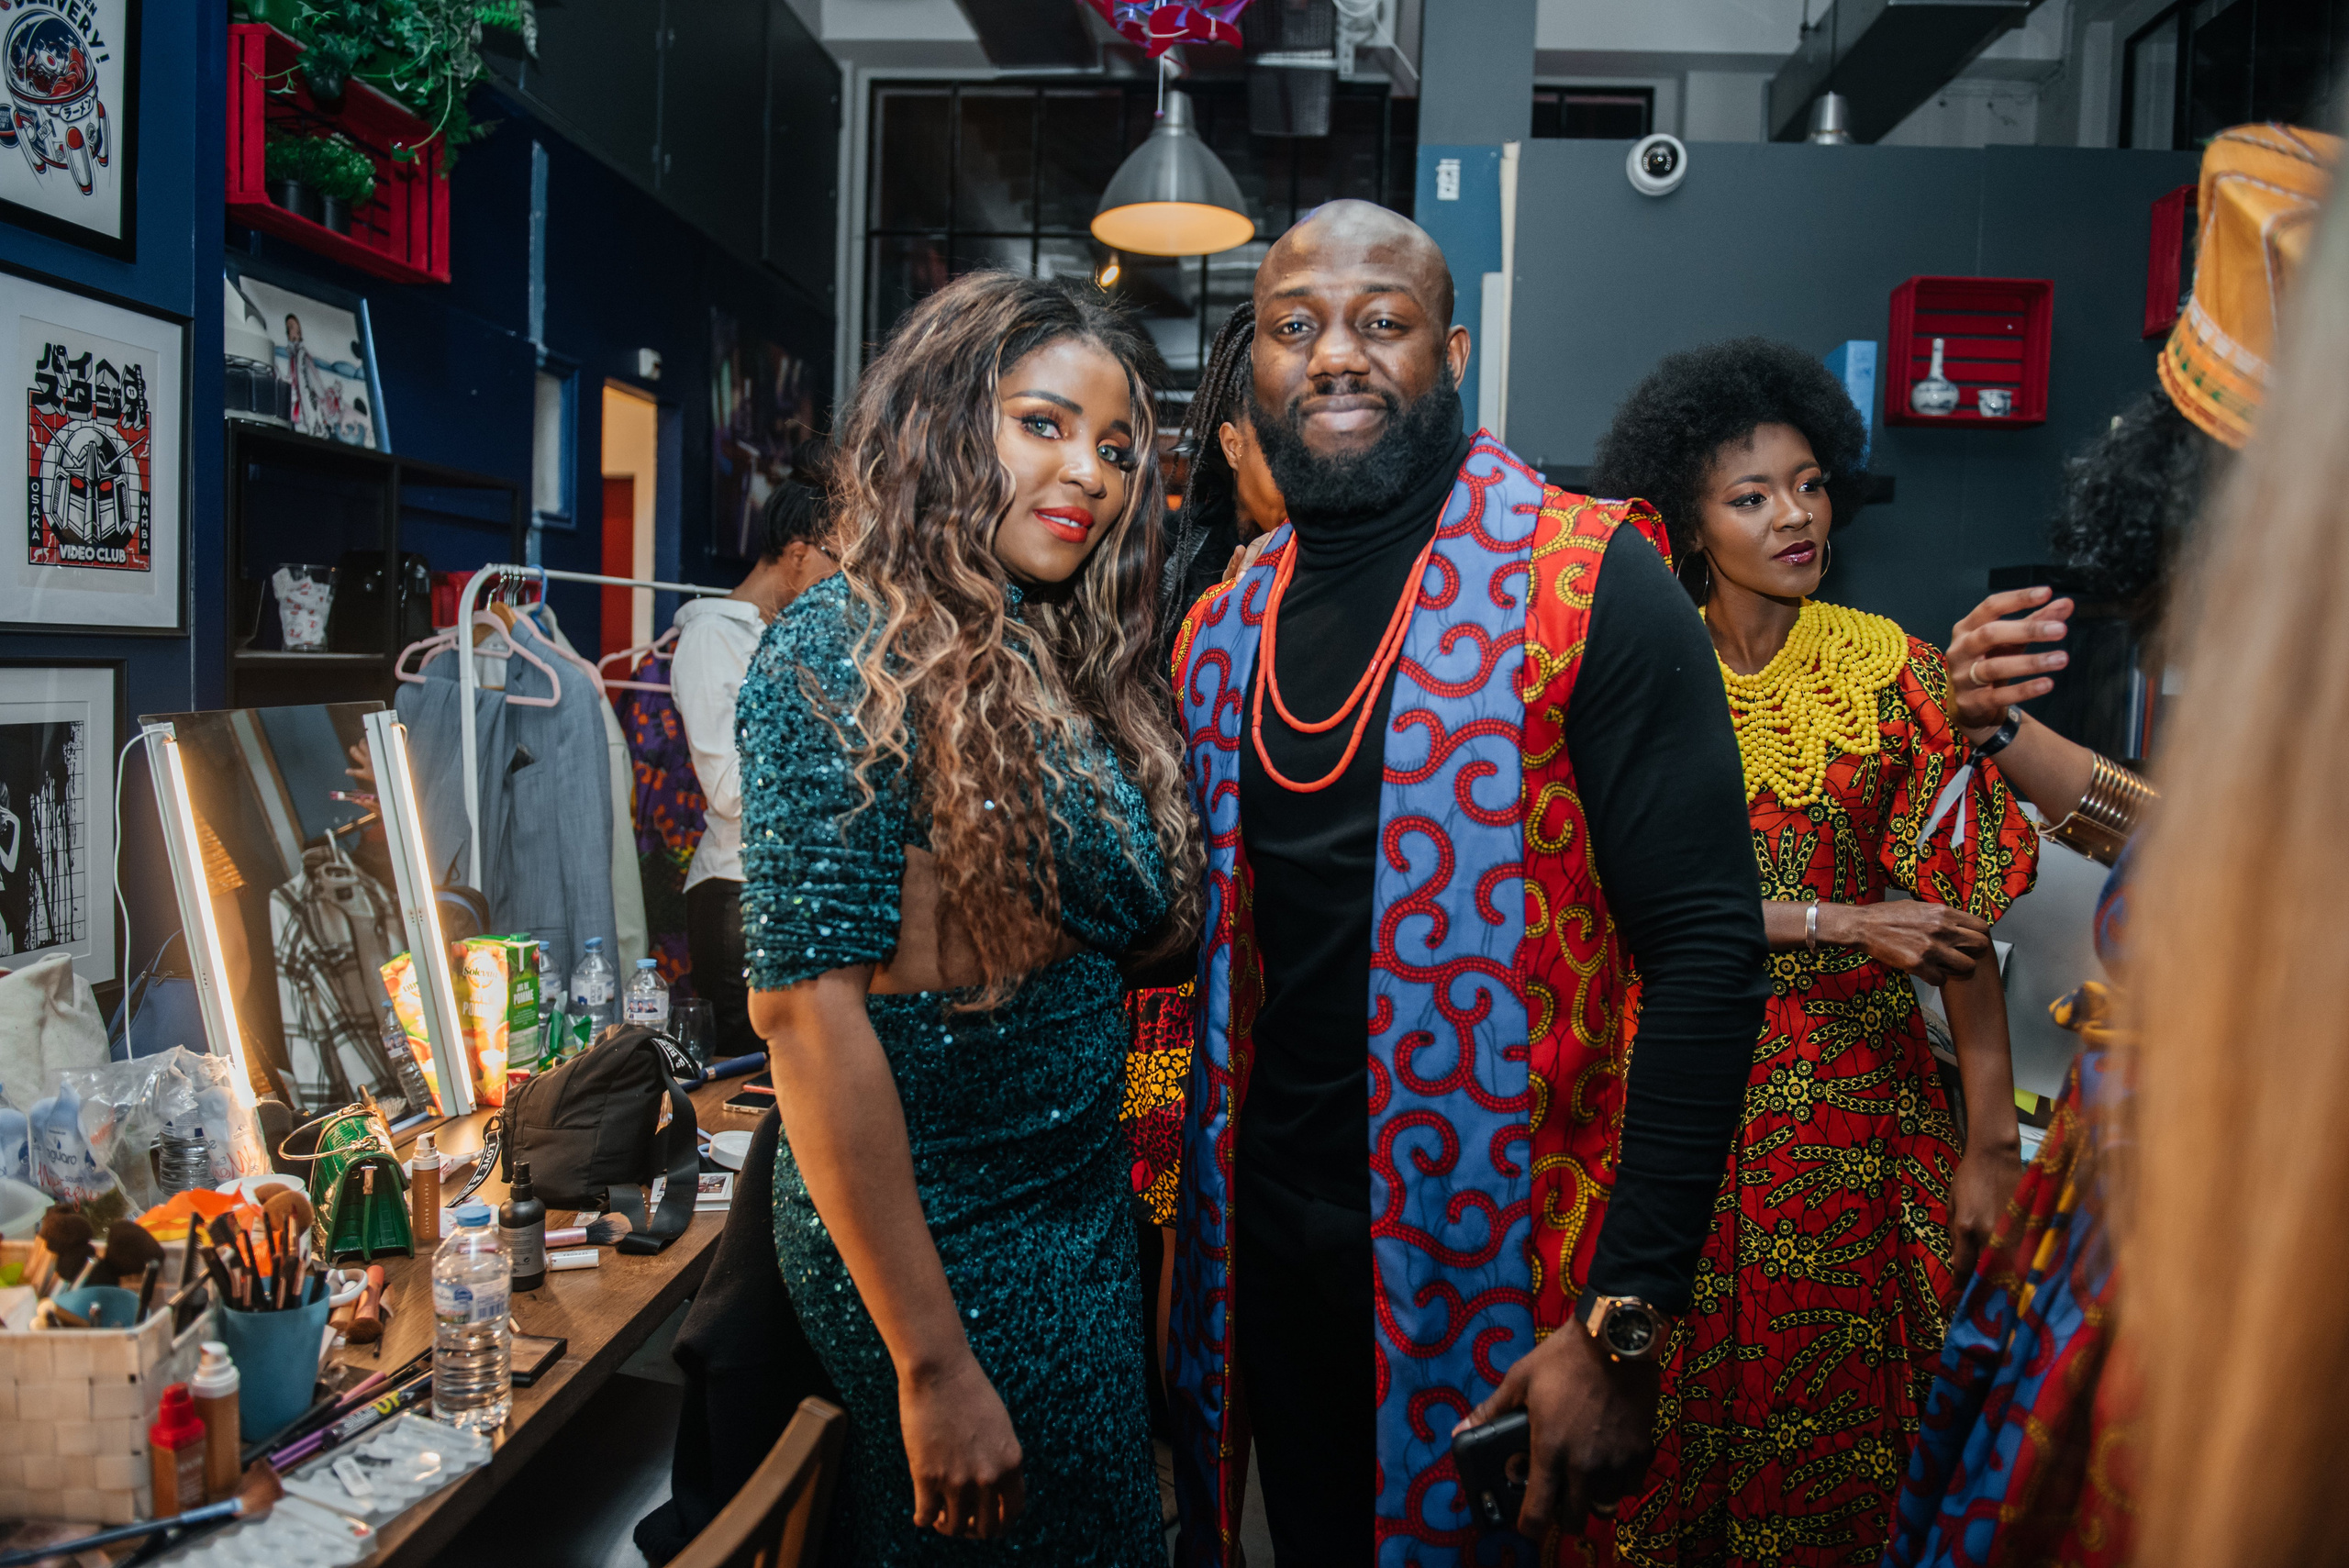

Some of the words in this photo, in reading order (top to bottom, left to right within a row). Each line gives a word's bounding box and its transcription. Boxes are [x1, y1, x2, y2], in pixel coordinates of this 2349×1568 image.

[63, 98, 91, 119] ラーメン
[30, 482, 40, 540] OSAKA
[140, 495, 149, 550] NAMBA
[59, 544, 95, 561] VIDEO
[96, 548, 127, 563] CLUB
[513, 988, 534, 1006] POMME
[480, 1142, 496, 1171] LOVE
[372, 1390, 401, 1415] UP
